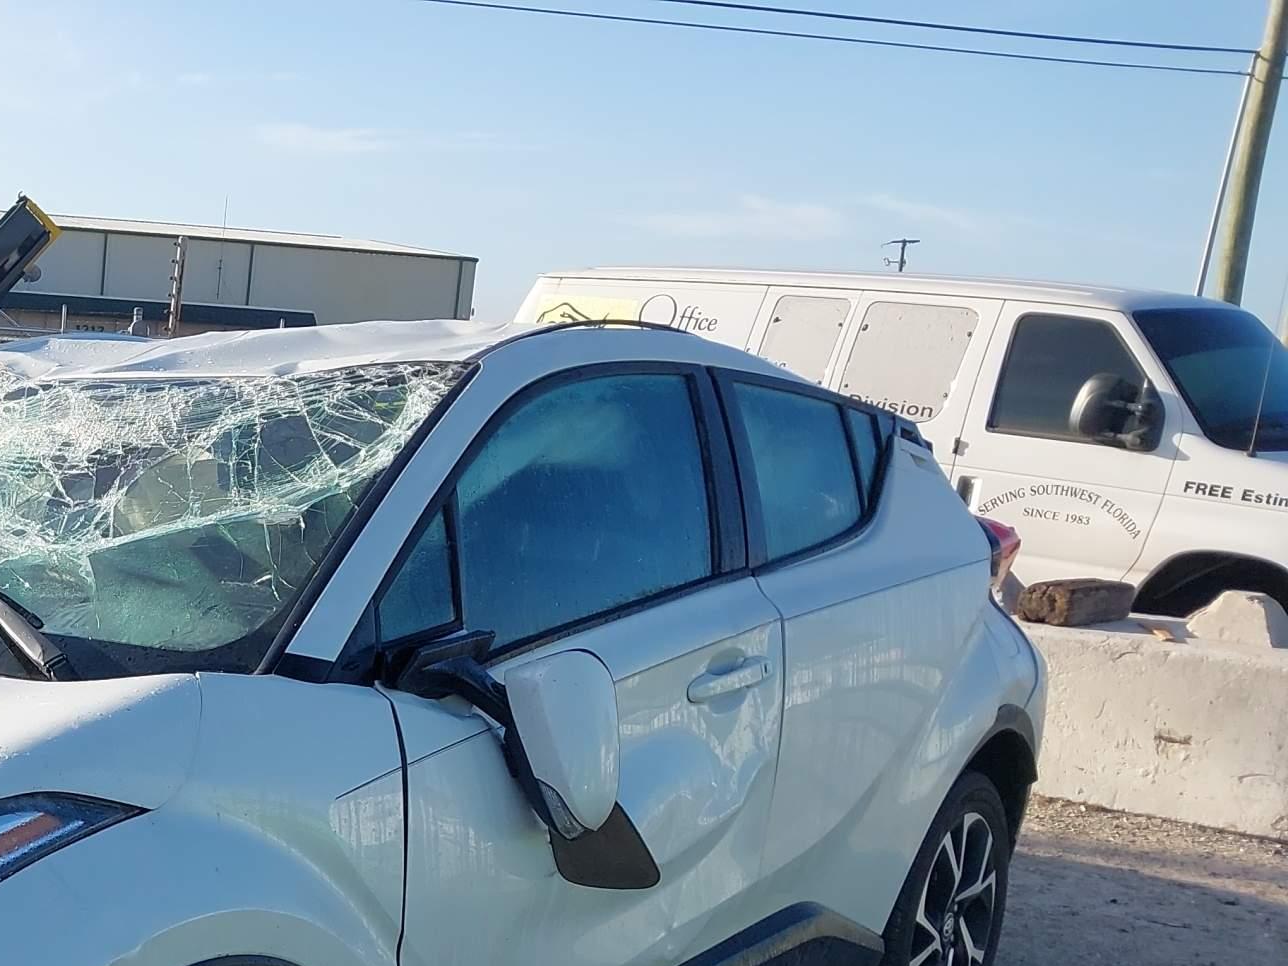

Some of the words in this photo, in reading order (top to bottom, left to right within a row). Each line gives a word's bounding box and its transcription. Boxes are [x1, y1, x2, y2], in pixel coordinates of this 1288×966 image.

[639, 294, 718, 333] Office
[1183, 480, 1235, 499] FREE
[977, 487, 1026, 516] SERVING
[1030, 484, 1102, 505] SOUTHWEST
[1100, 499, 1142, 540] FLORIDA
[1023, 507, 1061, 521] SINCE
[1065, 513, 1091, 526] 1983
